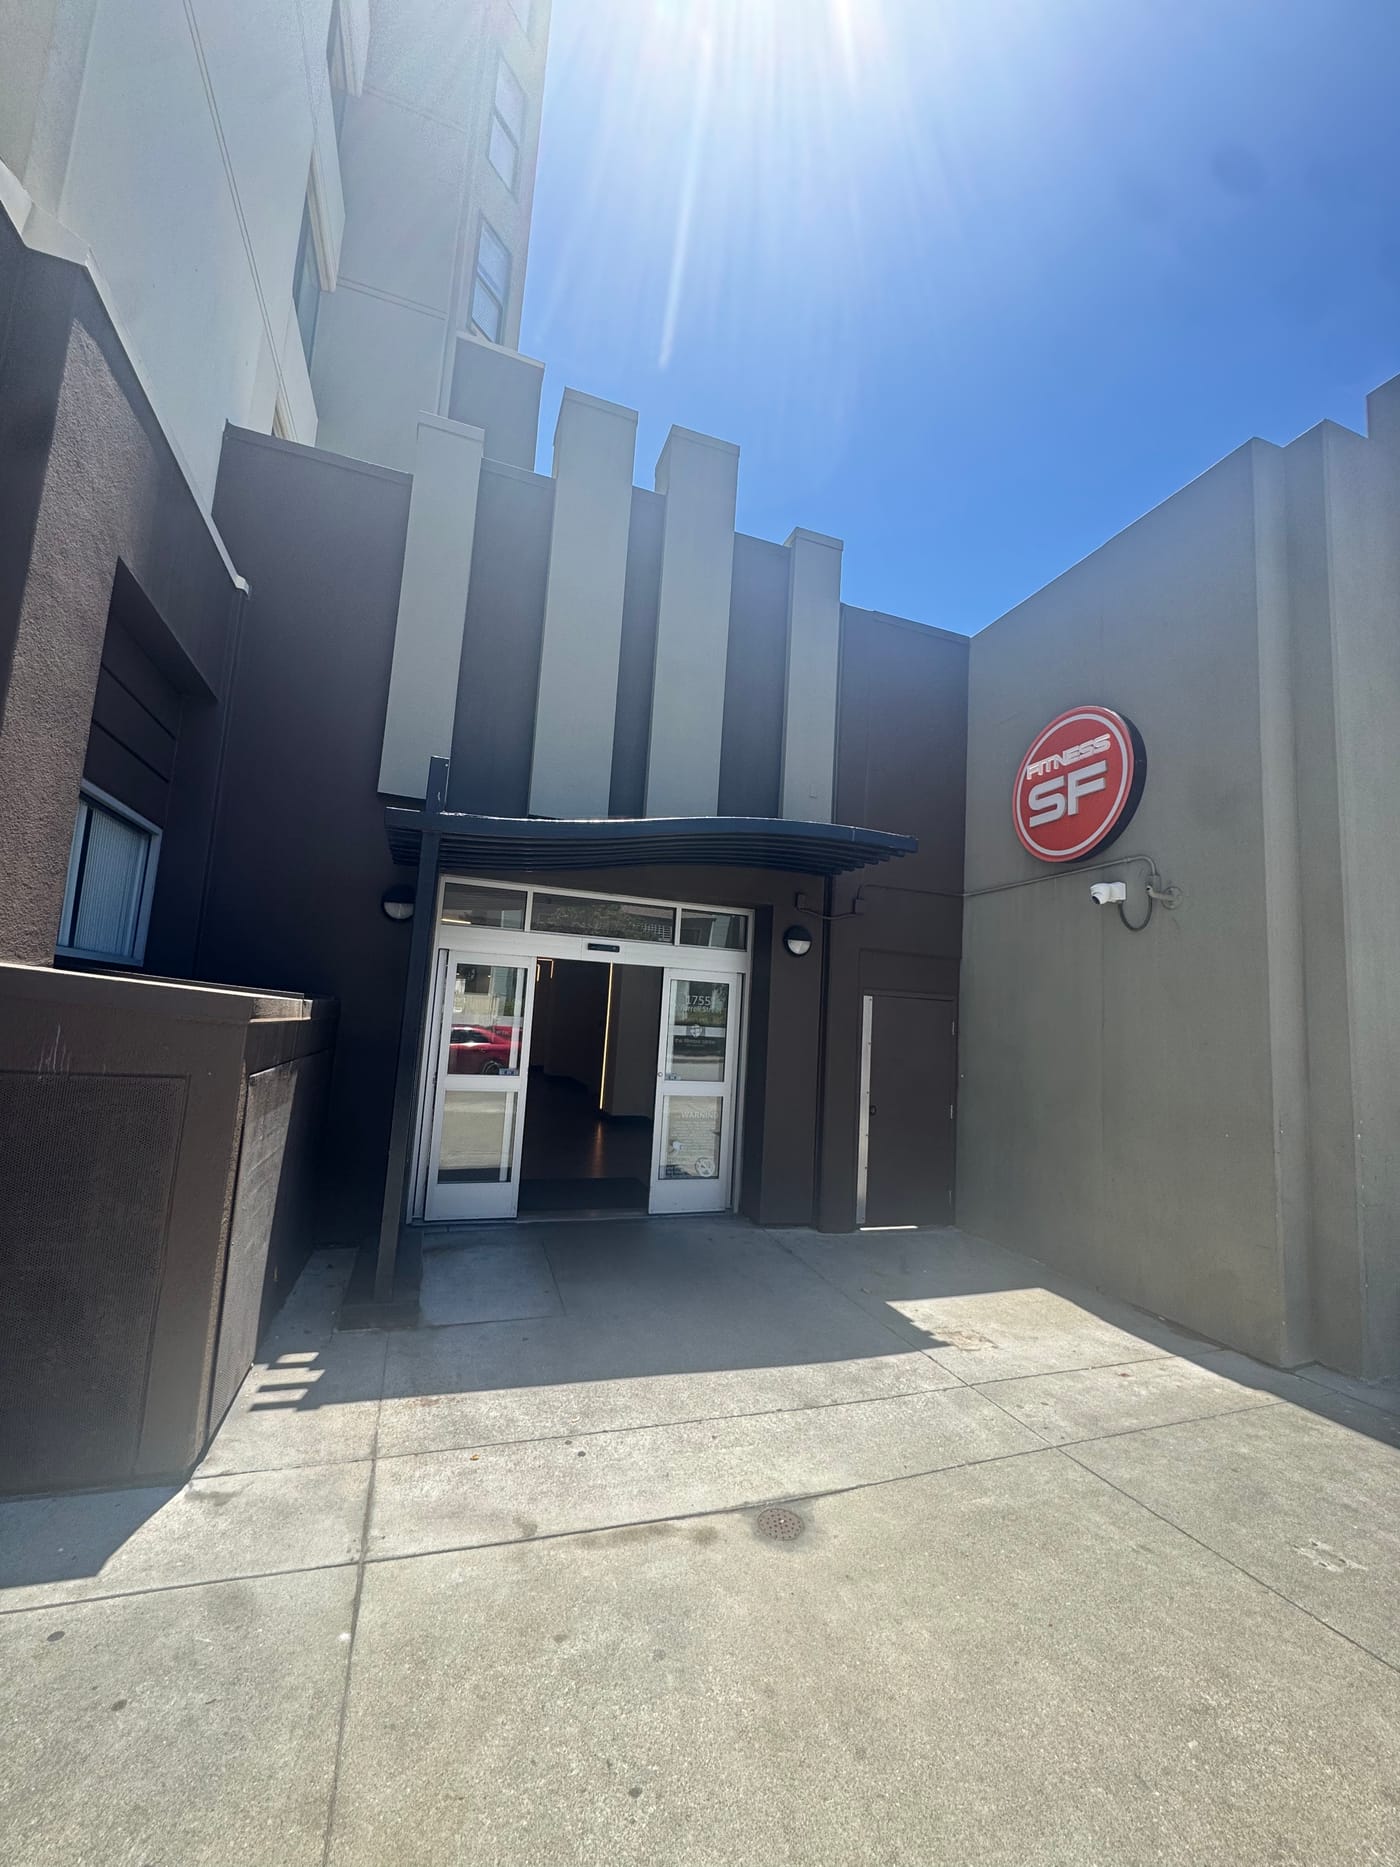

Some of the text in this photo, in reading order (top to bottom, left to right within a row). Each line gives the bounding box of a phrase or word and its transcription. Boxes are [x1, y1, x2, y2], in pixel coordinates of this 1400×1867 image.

[1026, 733, 1111, 780] FITNESS
[1028, 759, 1108, 828] SF
[685, 995, 712, 1006] 1755
